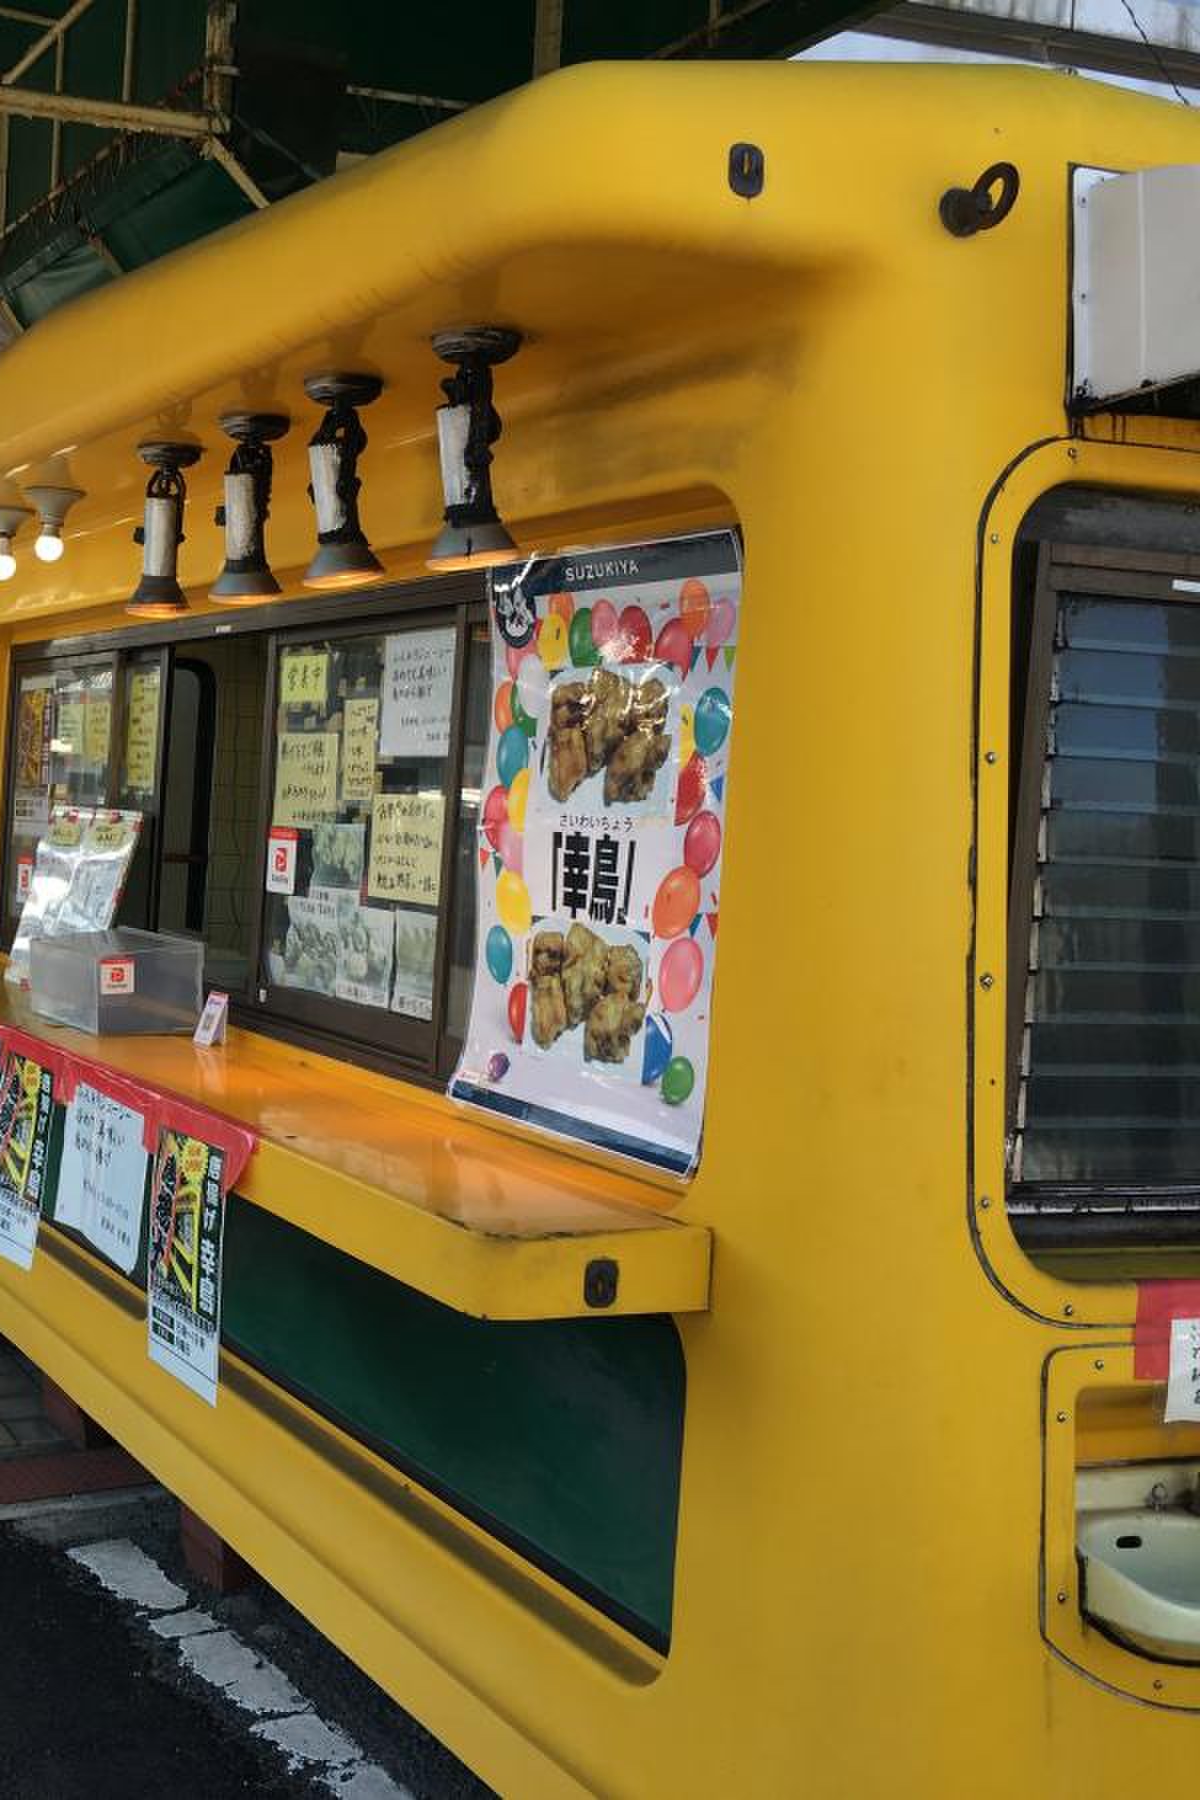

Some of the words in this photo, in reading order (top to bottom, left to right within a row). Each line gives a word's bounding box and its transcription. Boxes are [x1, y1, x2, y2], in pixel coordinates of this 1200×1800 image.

[565, 559, 640, 582] SUZUKIYA
[559, 814, 634, 833] さいわいちょう
